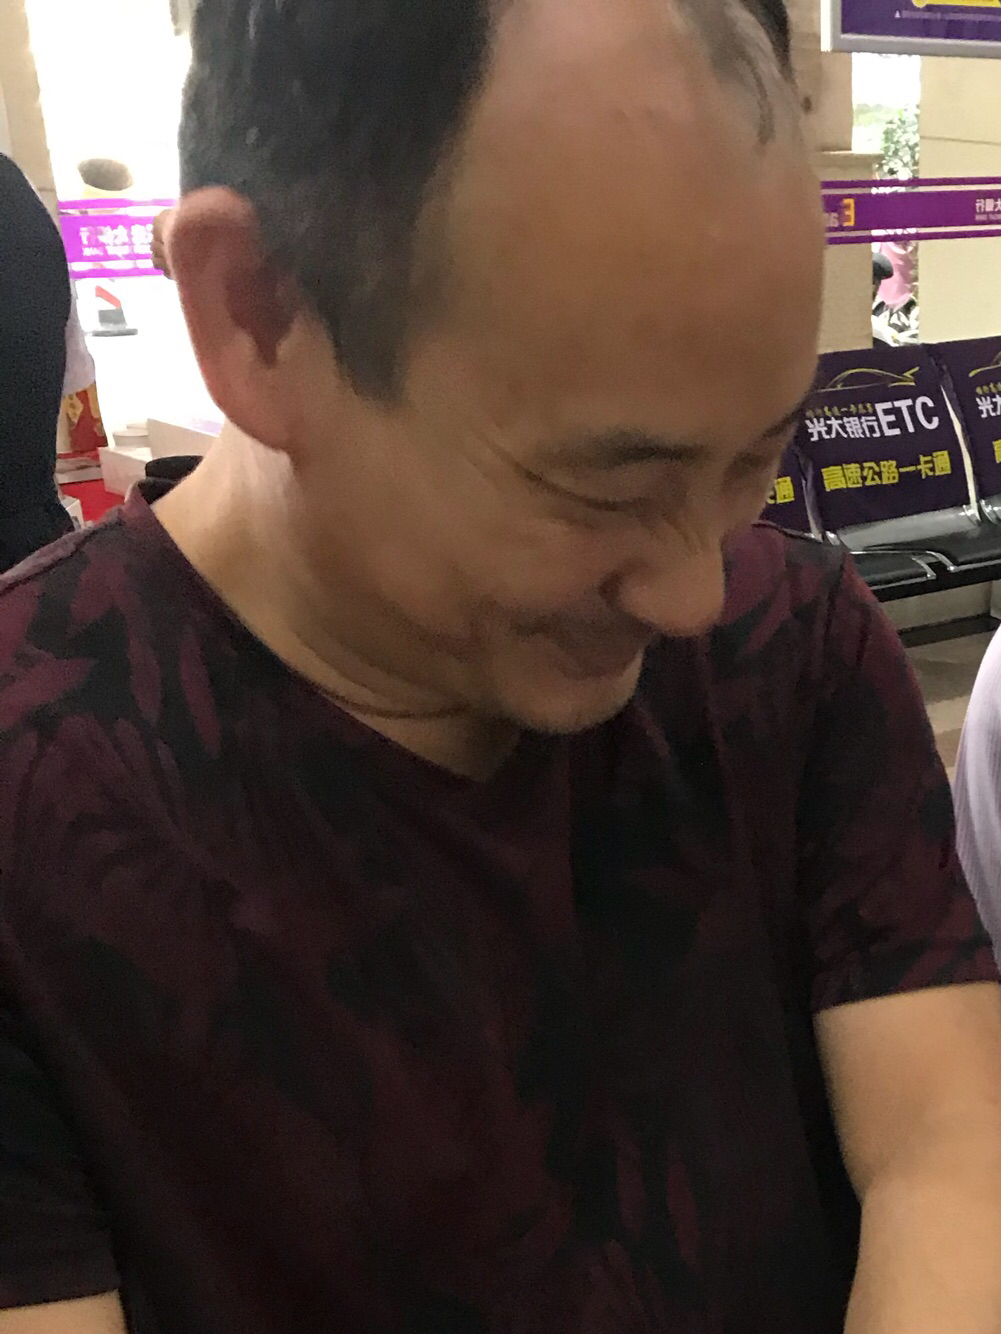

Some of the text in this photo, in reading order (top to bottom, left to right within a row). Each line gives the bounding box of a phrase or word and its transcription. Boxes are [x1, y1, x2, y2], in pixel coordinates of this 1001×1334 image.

[820, 450, 952, 492] 高速公路一卡通
[766, 475, 796, 505] 通
